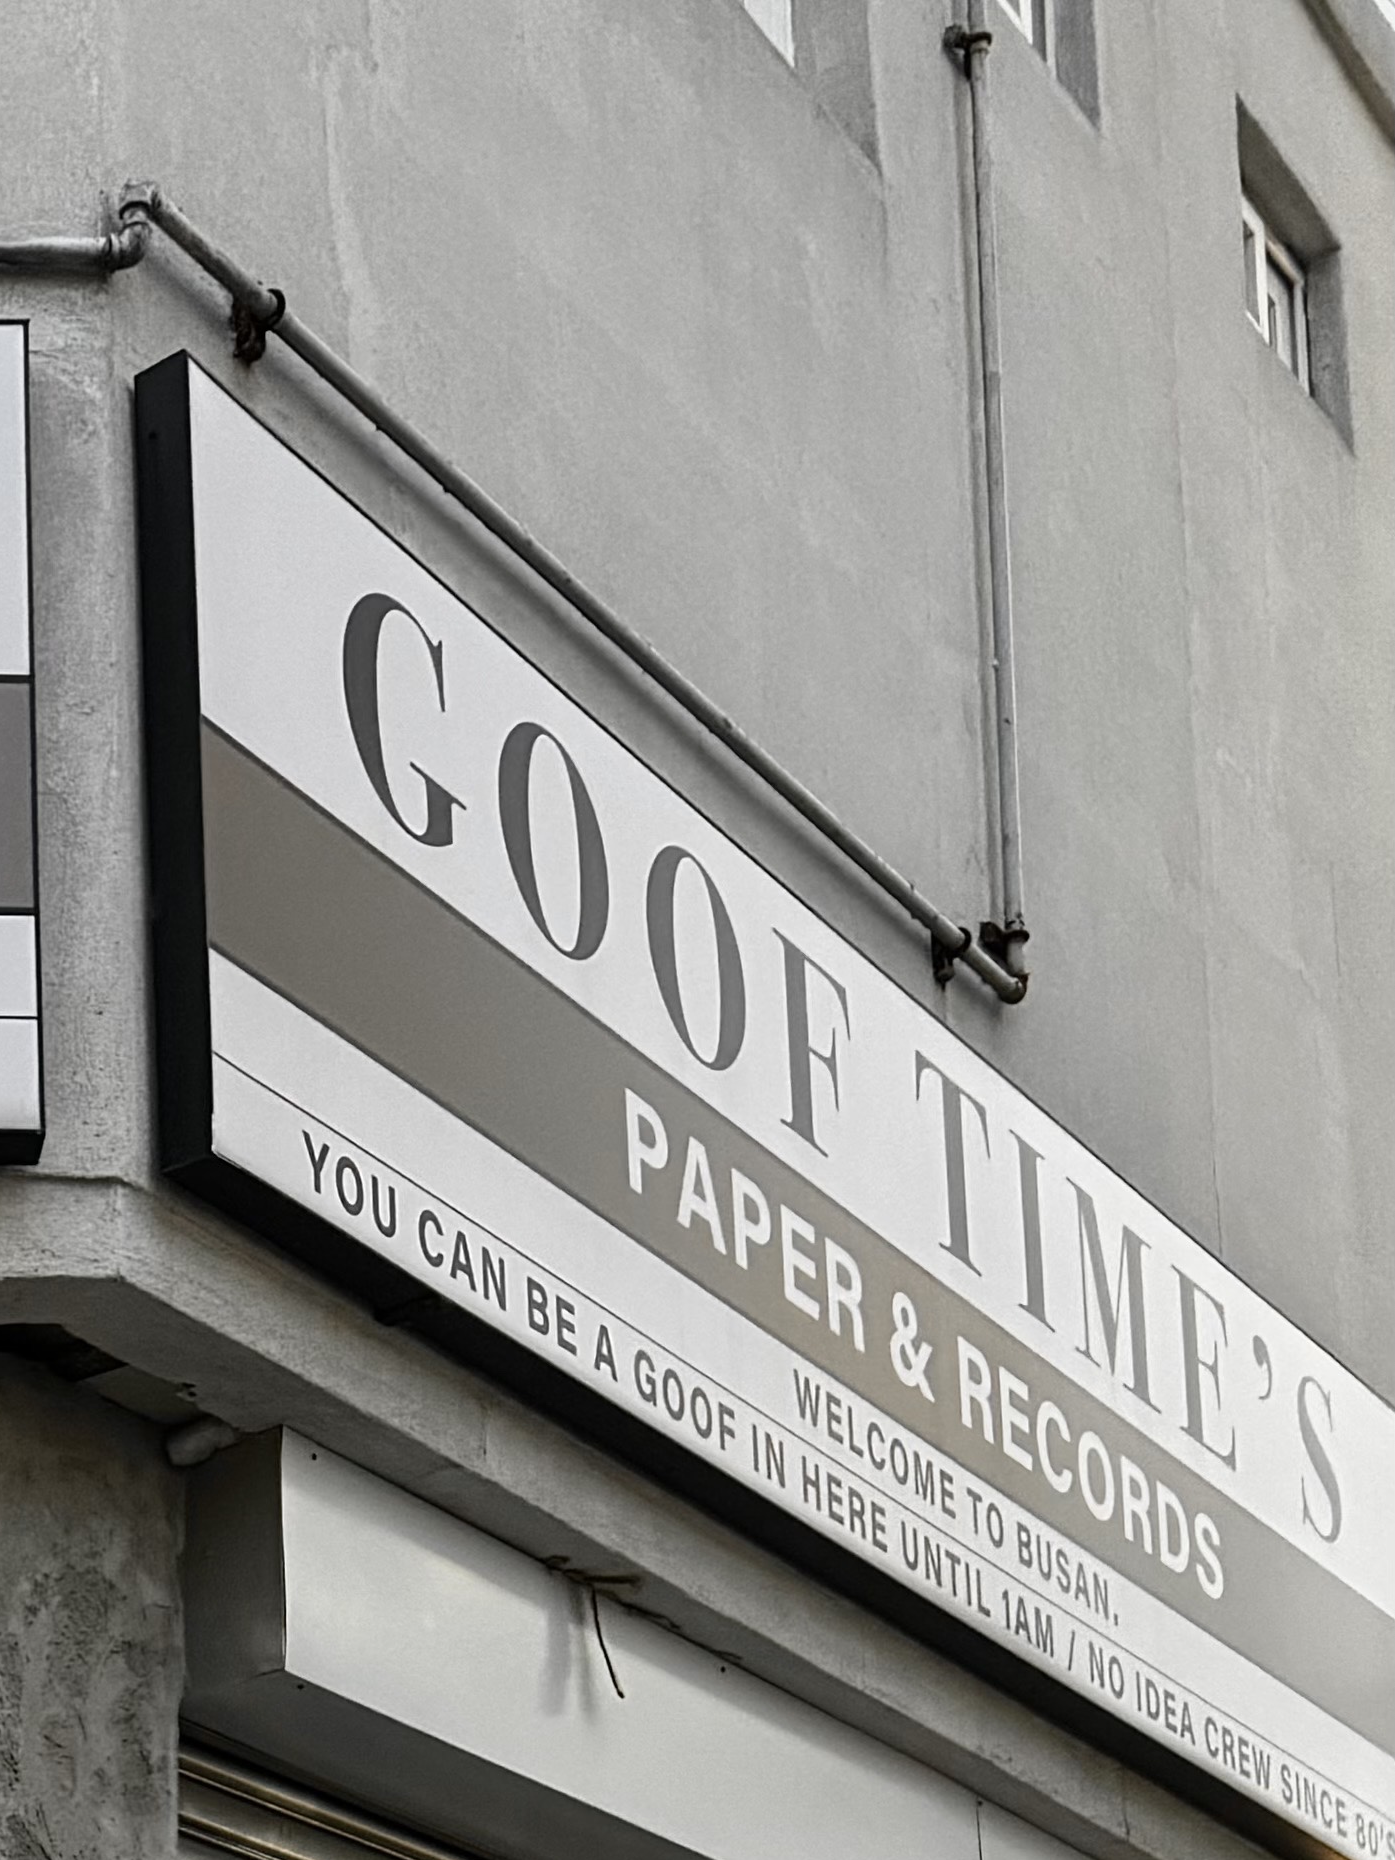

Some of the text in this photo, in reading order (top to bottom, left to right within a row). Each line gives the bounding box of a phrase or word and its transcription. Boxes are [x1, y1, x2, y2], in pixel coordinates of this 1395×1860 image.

[342, 592, 1341, 1543] GOOF TIME'S
[624, 1088, 1225, 1599] PAPER & RECORDS
[301, 1130, 397, 1238] YOU
[418, 1209, 506, 1311] CAN
[526, 1276, 577, 1355] BE
[594, 1324, 617, 1382] A
[633, 1349, 736, 1451] GOOF
[752, 1424, 786, 1488] IN
[802, 1463, 888, 1552] HERE
[901, 1519, 991, 1619] UNTIL
[1002, 1588, 1055, 1658] 1AM
[1067, 1612, 1077, 1672] /
[1089, 1639, 1124, 1699] NO
[1136, 1676, 1196, 1745] IDEA
[1204, 1716, 1271, 1790] CREW
[1281, 1755, 1348, 1838] SINCE
[794, 1369, 1119, 1626] WELCOME TO BUSAN.
